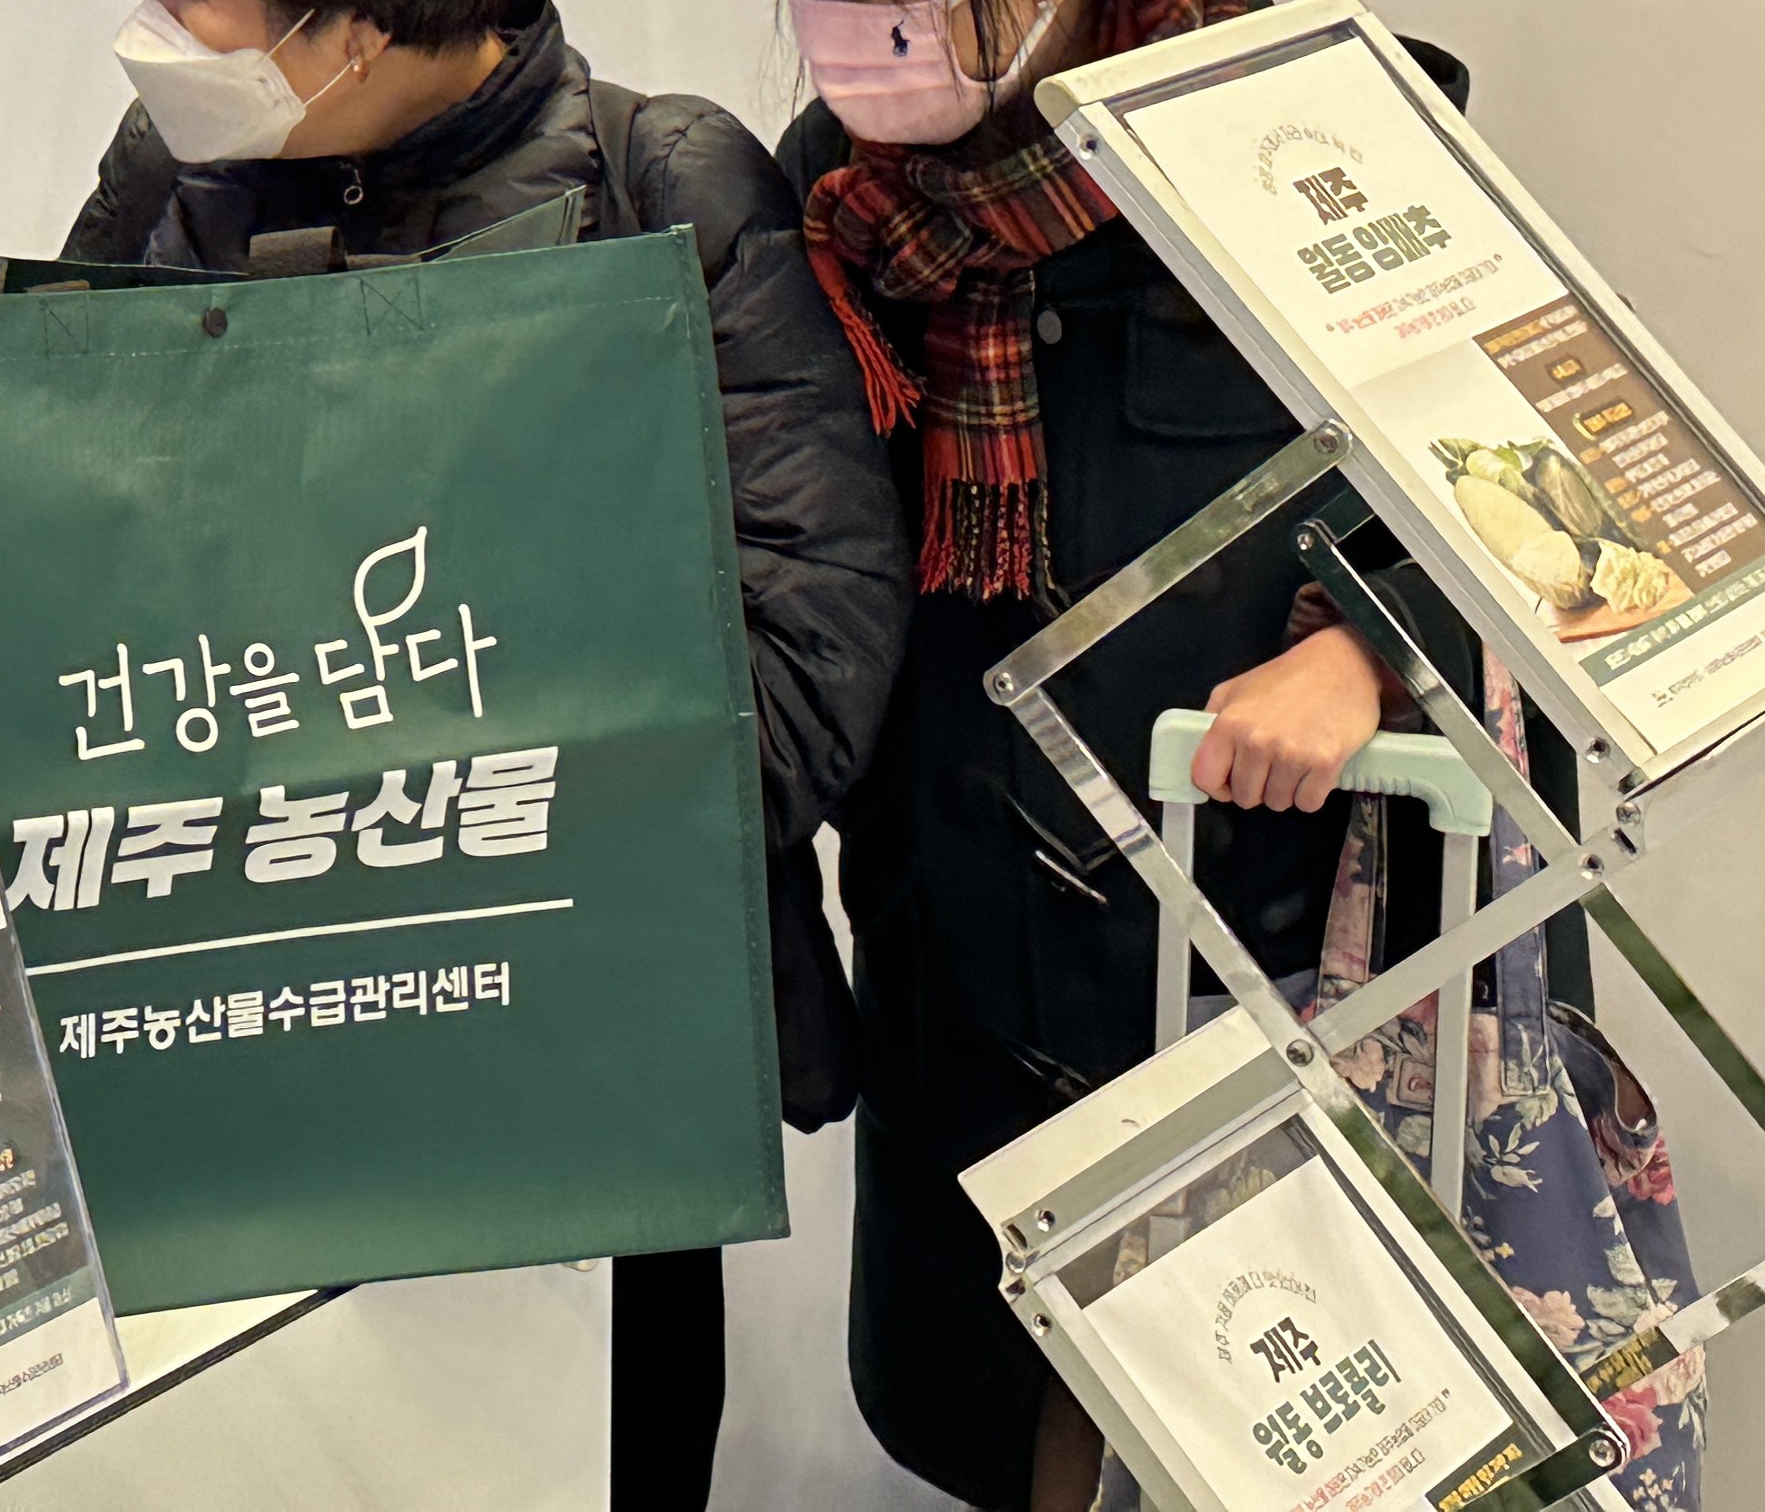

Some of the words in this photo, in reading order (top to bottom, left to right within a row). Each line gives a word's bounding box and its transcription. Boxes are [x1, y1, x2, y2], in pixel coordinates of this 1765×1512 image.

[1293, 167, 1369, 225] 제주
[58, 634, 300, 761] 건강을
[315, 527, 497, 730] 담다
[6, 797, 224, 912] 제주
[244, 746, 559, 883] 농산물
[59, 961, 511, 1059] 제주농산물수급관리센터
[1249, 1317, 1321, 1383] 제주
[1252, 1401, 1324, 1474] 월동
[1300, 1339, 1401, 1435] 브로콜리
